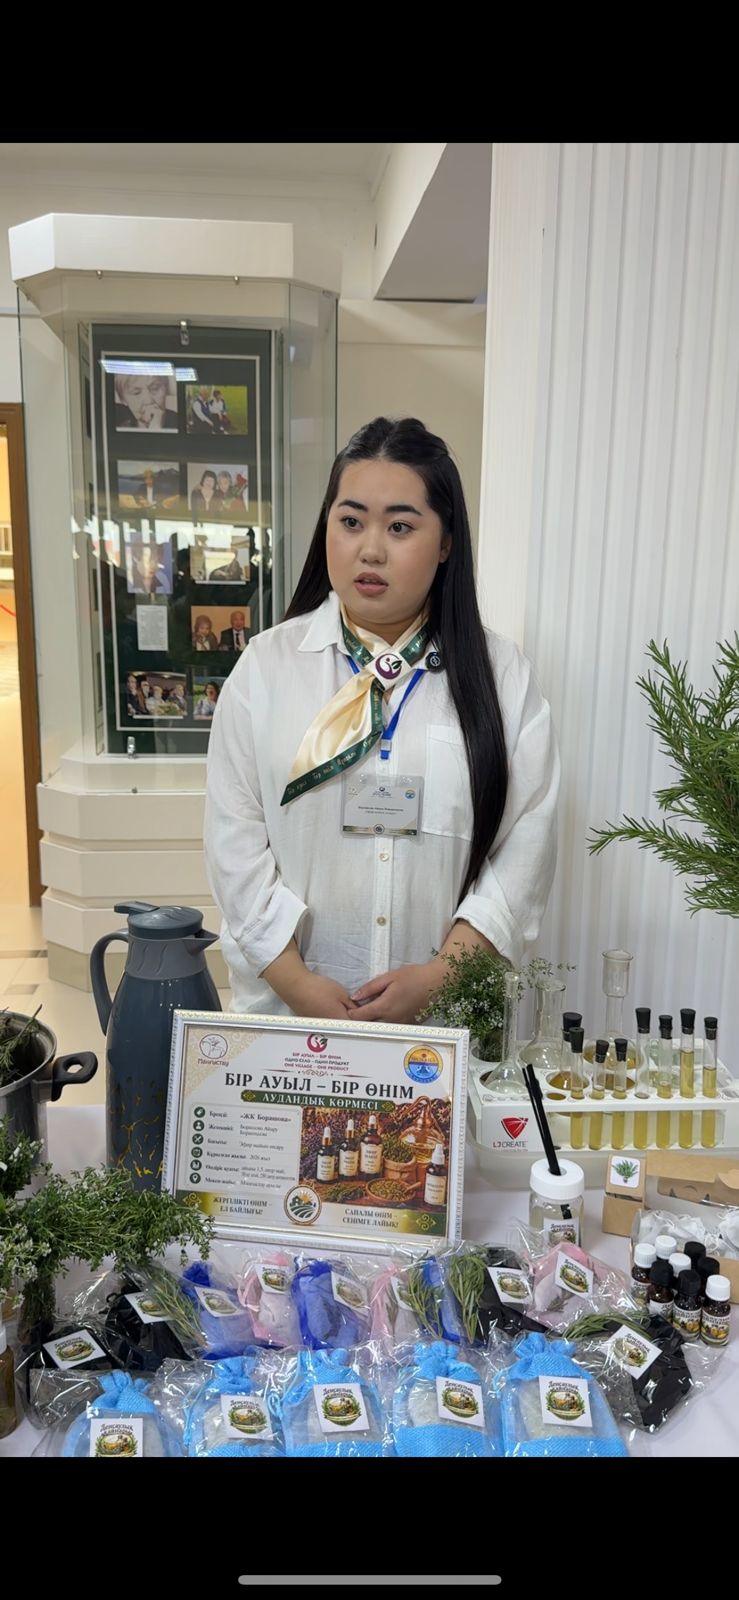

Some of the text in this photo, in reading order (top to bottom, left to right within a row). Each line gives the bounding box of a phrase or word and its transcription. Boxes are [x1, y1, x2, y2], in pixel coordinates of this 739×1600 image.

[225, 1072, 253, 1087] БІР
[259, 1075, 311, 1092] АУЫЛ
[331, 1081, 359, 1096] БІР
[365, 1083, 414, 1099] ӨНІМ
[329, 1099, 379, 1111] КӨРМЕСІ
